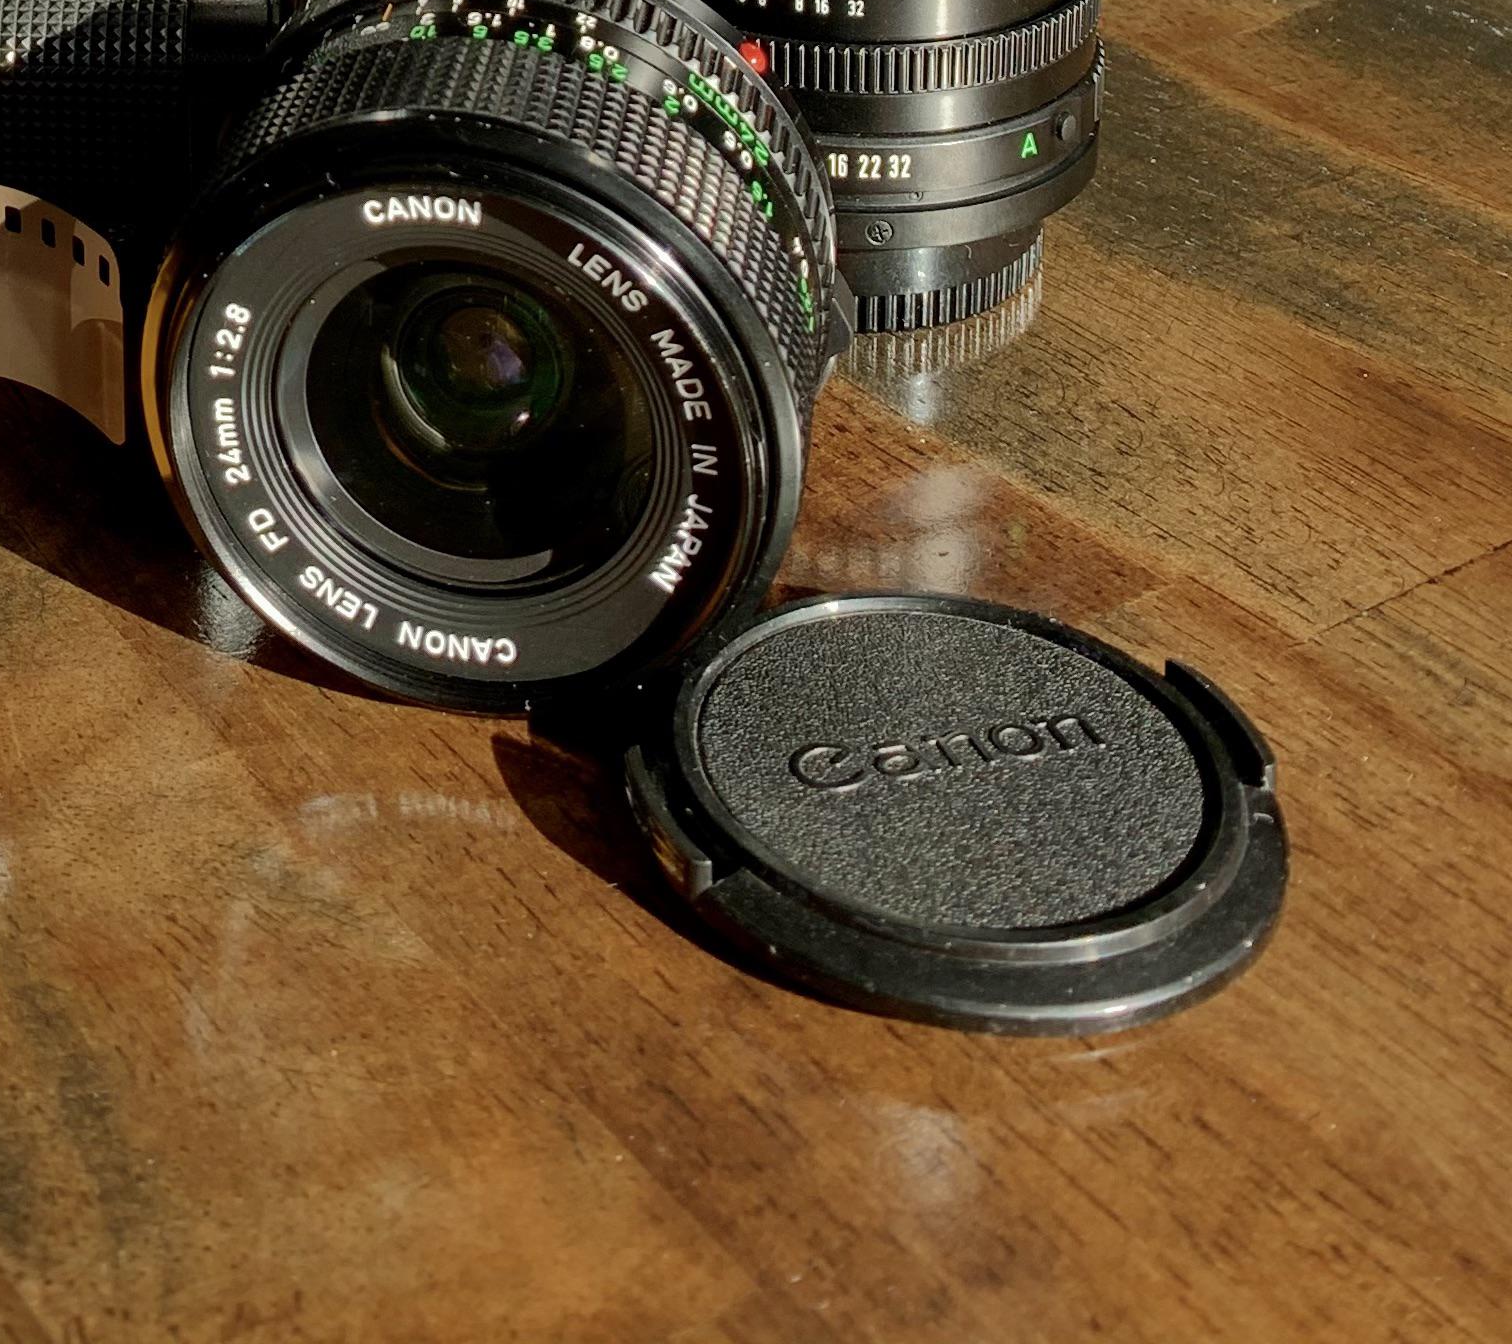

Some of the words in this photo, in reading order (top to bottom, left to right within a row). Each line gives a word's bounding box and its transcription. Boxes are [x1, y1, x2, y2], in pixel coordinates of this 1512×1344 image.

[847, 0, 865, 18] 32
[688, 71, 770, 168] 24mm
[827, 152, 849, 178] 16
[857, 154, 882, 179] 22
[888, 154, 912, 179] 32
[1021, 132, 1038, 159] A
[362, 195, 482, 225] CANON
[567, 243, 649, 313] LENS
[210, 302, 252, 378] 1:2.8
[650, 328, 713, 421] MADE
[211, 397, 251, 486] 24mm
[690, 443, 719, 476] IN
[247, 508, 289, 551] FD
[648, 494, 713, 595] JAPAN
[299, 564, 380, 630] LENS
[398, 619, 518, 665] CANON
[786, 709, 1108, 793] Canon
